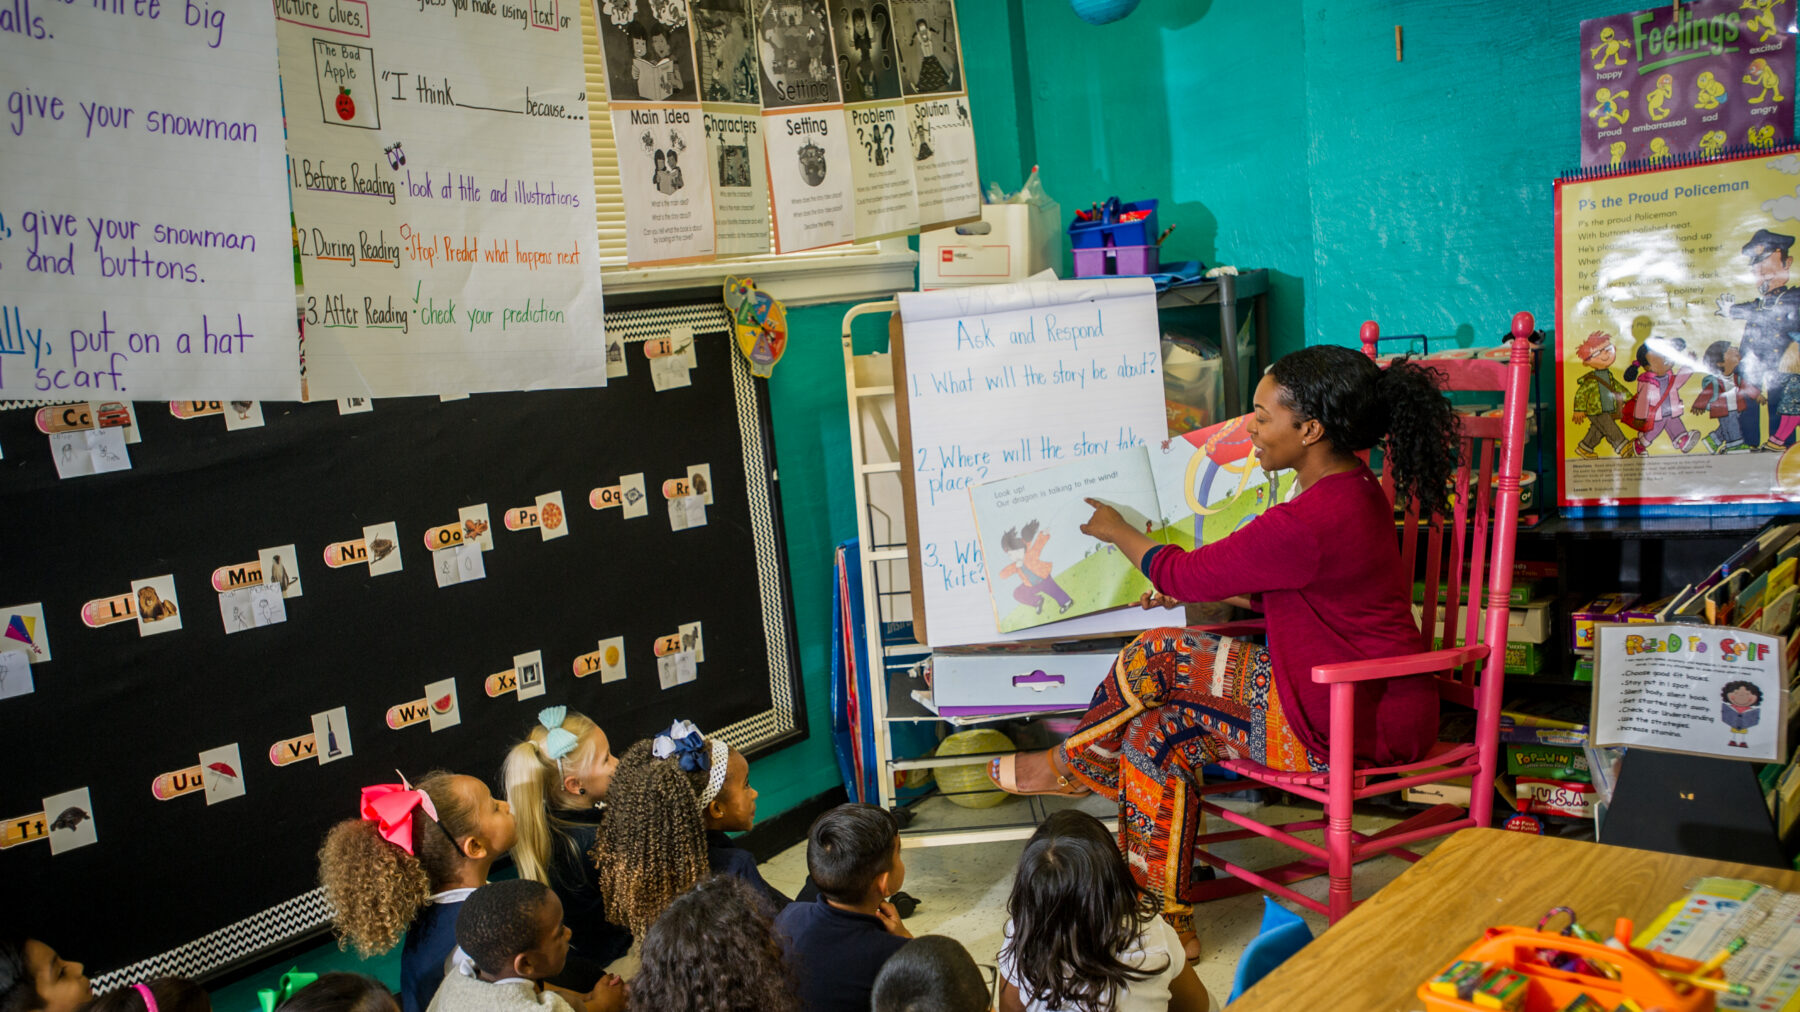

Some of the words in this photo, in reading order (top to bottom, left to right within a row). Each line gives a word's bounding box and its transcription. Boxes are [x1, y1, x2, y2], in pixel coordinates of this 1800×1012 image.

[185, 0, 226, 48] big
[329, 0, 363, 28] clues.
[472, 0, 497, 16] make
[502, 4, 528, 30] using
[534, 0, 555, 25] text
[560, 14, 571, 29] or
[1632, 7, 1741, 63] Feelings
[318, 42, 338, 58] The
[341, 46, 361, 61] Bad
[1749, 42, 1783, 55] excited
[323, 59, 357, 84] Apple
[1596, 70, 1623, 80] happy
[416, 74, 454, 106] think
[776, 79, 830, 102] Setting
[8, 88, 65, 136] give
[80, 102, 135, 138] your
[147, 110, 257, 143] snowman
[631, 109, 659, 125] Main
[663, 109, 690, 124] Idea
[852, 109, 896, 126] Problem
[915, 102, 950, 119] Solution
[703, 114, 757, 134] Characters
[786, 117, 828, 136] Setting
[1598, 127, 1623, 139] proud
[1632, 117, 1687, 133] embarrassed
[1702, 113, 1718, 123] sad
[1750, 105, 1778, 116] angry
[304, 160, 347, 192] Before
[351, 158, 396, 205] Reading
[406, 169, 432, 199] look
[441, 171, 453, 199] at
[458, 173, 482, 202] title
[490, 171, 508, 203] and
[514, 180, 581, 208] illustrations
[1578, 199, 1596, 211] P's
[1601, 196, 1623, 210] the
[1628, 189, 1669, 205] Proud
[1674, 179, 1750, 200] Policeman
[1592, 217, 1604, 226] the
[1607, 214, 1632, 226] proud
[22, 210, 78, 253] give
[87, 217, 141, 252] your
[154, 223, 256, 252] snowman
[1578, 232, 1597, 240] With
[1676, 234, 1698, 242] hand
[1701, 232, 1712, 242] up
[312, 228, 356, 267] During
[359, 230, 401, 269] Reading
[444, 235, 478, 263] Predict
[485, 239, 509, 263] what
[515, 240, 552, 271] happens
[557, 240, 581, 265] next
[1681, 247, 1695, 255] the
[26, 243, 74, 276] and
[100, 246, 206, 283] buttons.
[1578, 284, 1590, 292] He
[323, 294, 359, 327] After
[365, 295, 409, 334] Reading
[421, 299, 456, 325] check
[468, 309, 493, 332] your
[503, 298, 565, 331] prediction
[70, 310, 115, 368] put
[128, 333, 160, 354] on
[176, 333, 191, 354] a
[203, 313, 254, 355] hat
[957, 318, 995, 350] Ask
[1009, 316, 1036, 344] and
[1045, 309, 1104, 351] Respond
[35, 352, 128, 392] scarf.
[931, 367, 975, 394] What
[985, 365, 1016, 392] will
[1024, 364, 1046, 387] the
[1053, 359, 1085, 389] story
[1092, 359, 1108, 380] be
[1117, 351, 1158, 379] about?
[62, 408, 90, 427] Cc
[917, 447, 935, 472] 2.
[938, 439, 991, 470] Where
[1003, 438, 1031, 463] will
[1040, 436, 1064, 459] the
[1073, 431, 1108, 457] story
[1116, 427, 1146, 449] take
[676, 483, 689, 496] Rr
[928, 465, 988, 506] place?
[994, 488, 1010, 499] Look
[996, 499, 1009, 508] Our
[1012, 492, 1038, 505] dragon
[1048, 483, 1072, 496] talking
[1084, 477, 1096, 485] the
[1098, 471, 1119, 482] wind!
[519, 510, 538, 526] Pp
[439, 529, 461, 544] Oo
[341, 545, 367, 561] Nn
[924, 543, 943, 568] 3.
[228, 568, 262, 586] Mm
[942, 563, 986, 591] kite?
[498, 675, 516, 690] Xx
[399, 705, 429, 722] Ww
[1638, 698, 1668, 706] started
[1669, 701, 1688, 709] right
[288, 741, 314, 757] Vv
[173, 774, 202, 791] Uu
[1536, 787, 1589, 807] U.S.A.
[17, 821, 44, 839] Tt
